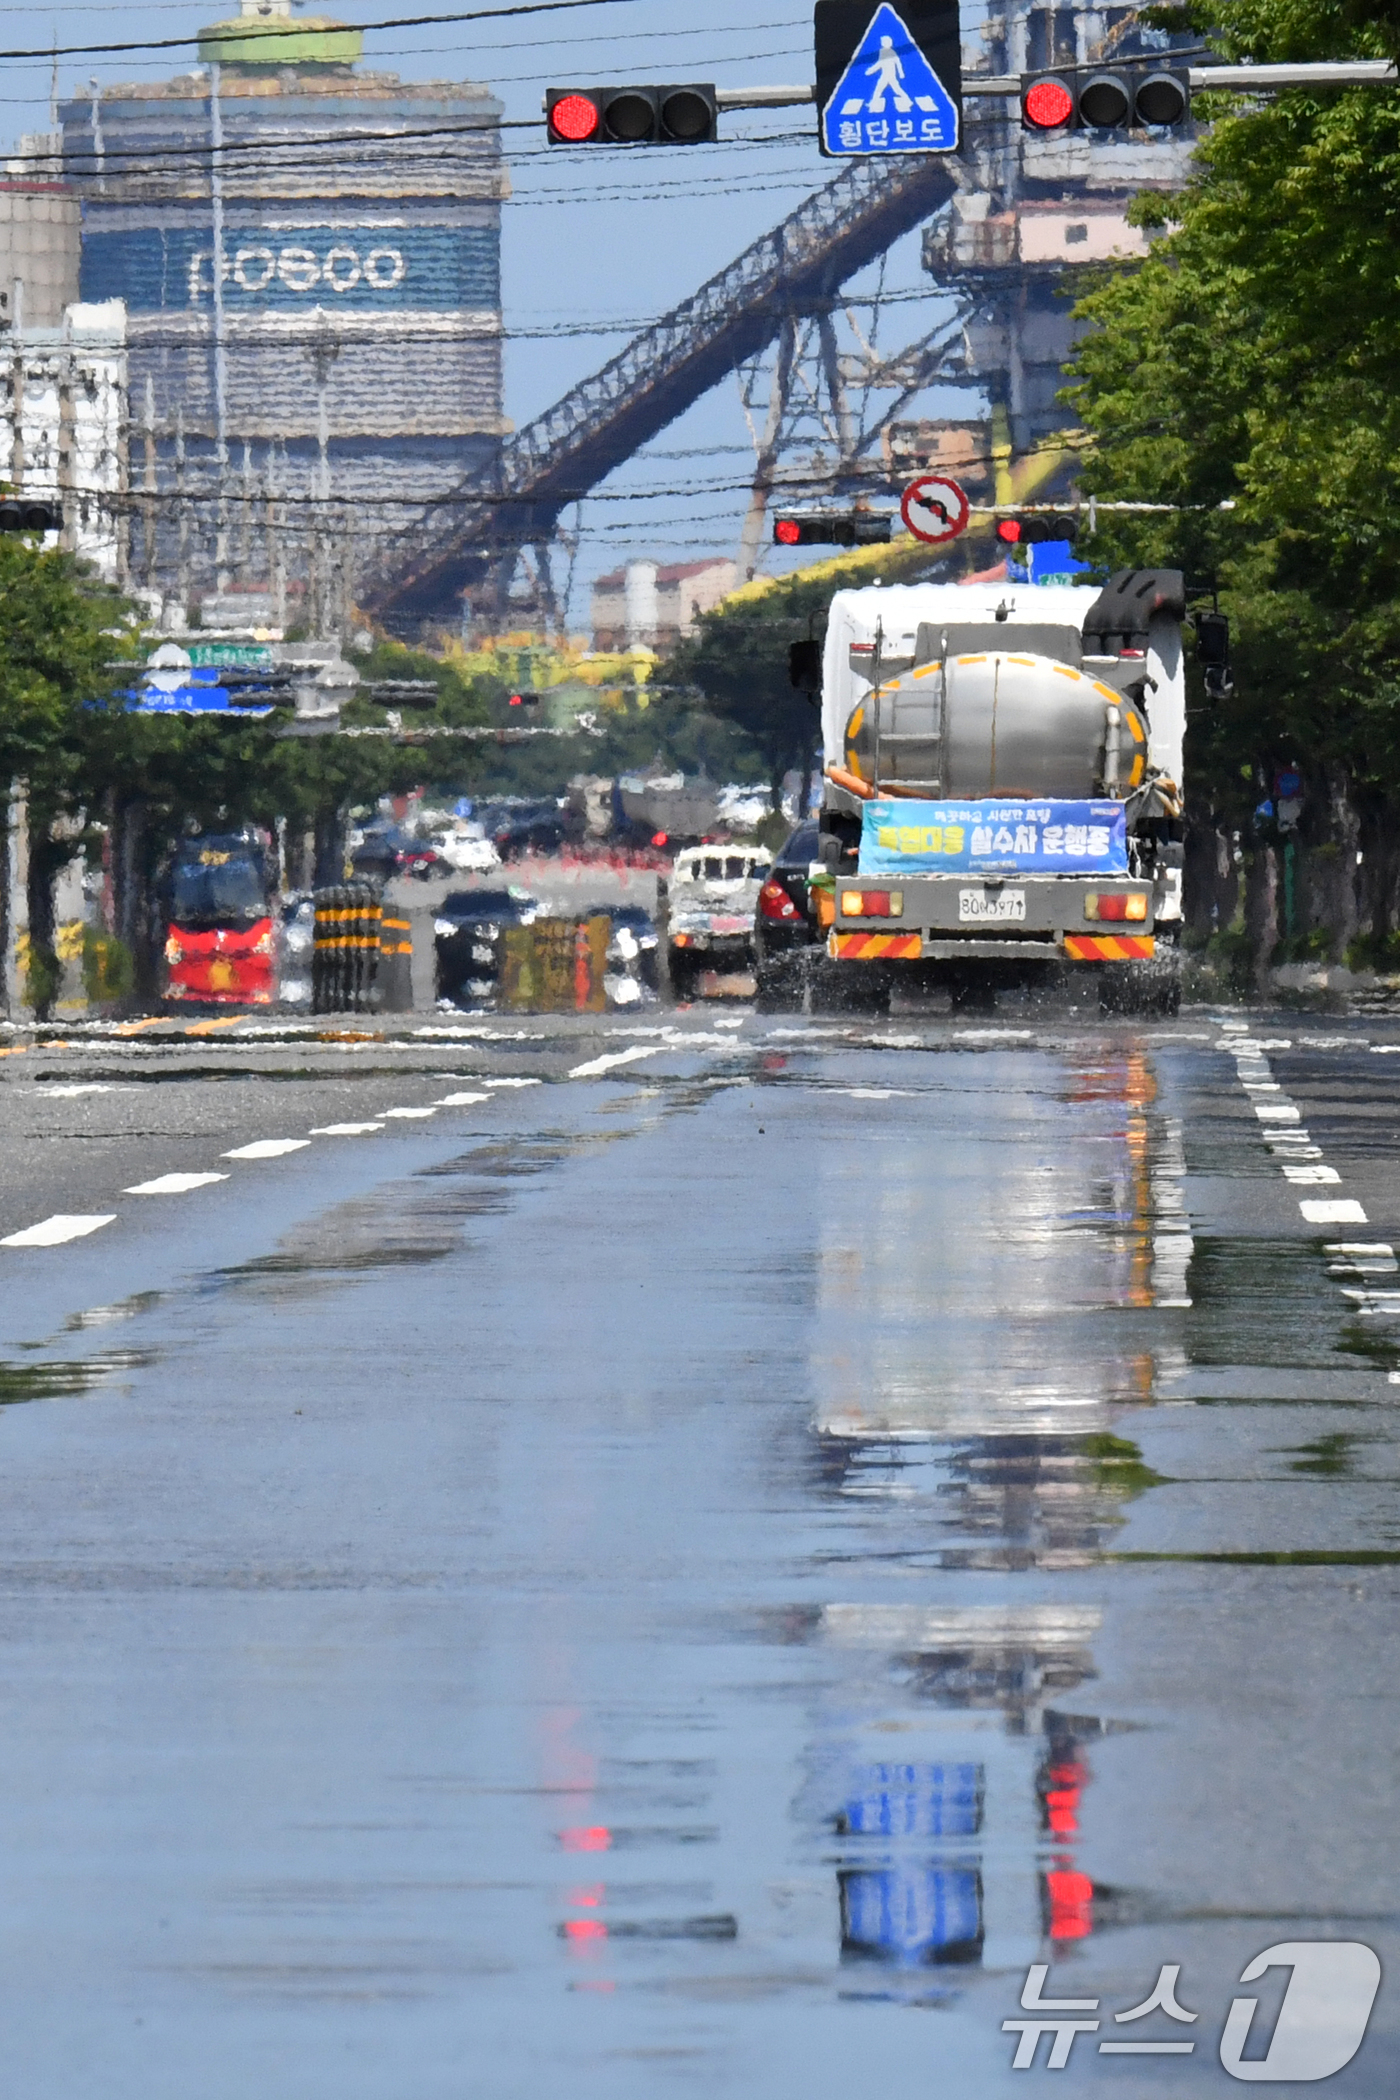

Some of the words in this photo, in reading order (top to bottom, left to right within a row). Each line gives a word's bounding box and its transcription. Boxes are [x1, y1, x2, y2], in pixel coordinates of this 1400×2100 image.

[838, 118, 944, 148] 횡단보도
[987, 808, 1023, 822] 시원한
[1026, 808, 1051, 824] 포항
[970, 824, 1038, 855] 살수차
[1042, 824, 1110, 856] 운행중
